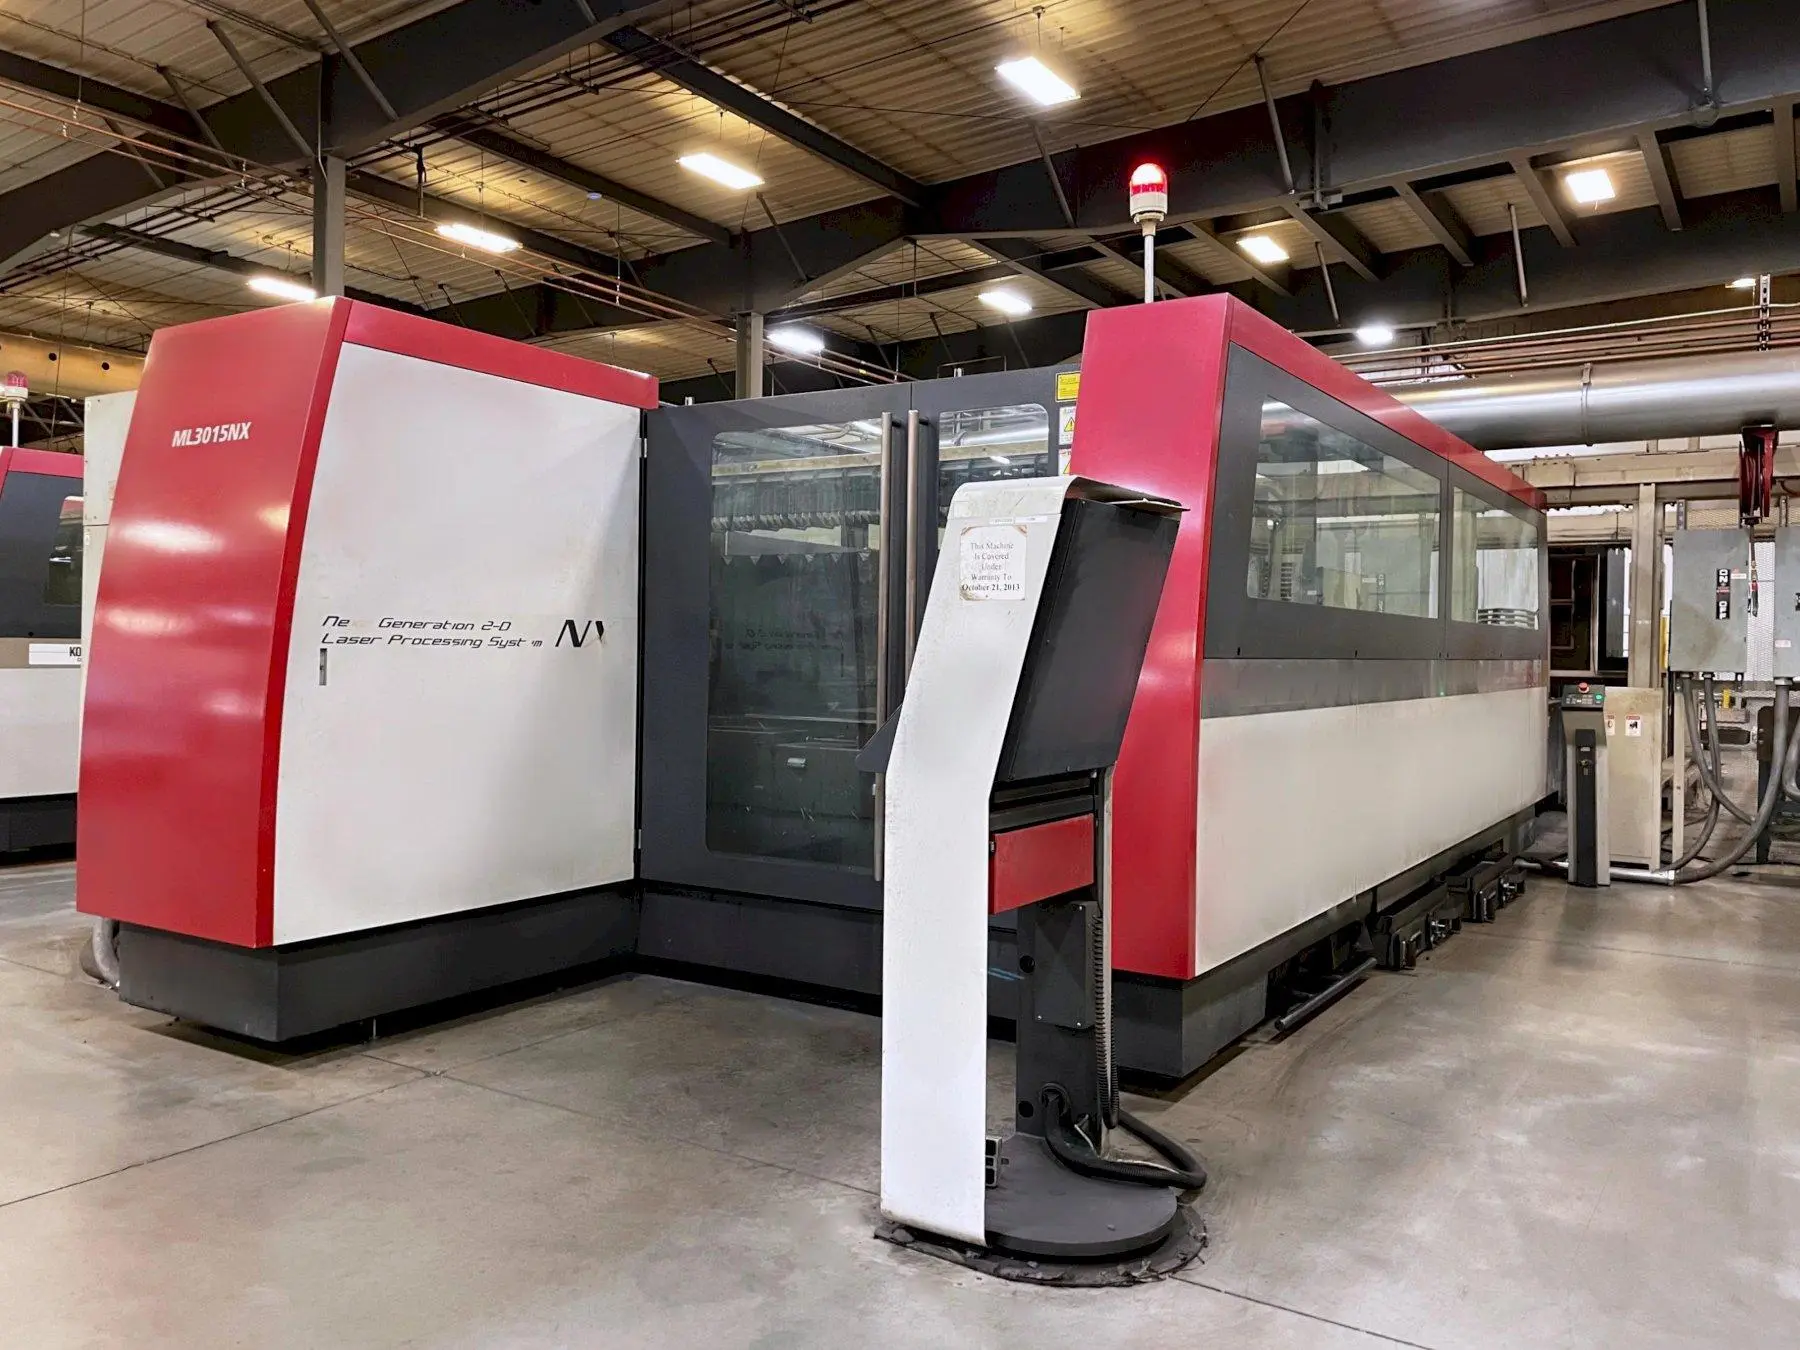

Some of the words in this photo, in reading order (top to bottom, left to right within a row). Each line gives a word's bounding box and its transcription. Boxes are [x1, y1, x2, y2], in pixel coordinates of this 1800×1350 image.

[171, 421, 252, 448] ML3015NX
[971, 542, 984, 550] This
[986, 542, 1014, 550] Machine
[981, 552, 1009, 560] Covered
[971, 573, 1000, 583] Warranty
[962, 583, 989, 592] October
[991, 583, 1002, 592] 21,
[1003, 583, 1020, 592] 2013
[378, 617, 475, 630] Generation
[481, 620, 512, 631] 2-D
[321, 633, 383, 644] Laser
[387, 634, 483, 649] Processing
[487, 636, 543, 649] Systm
